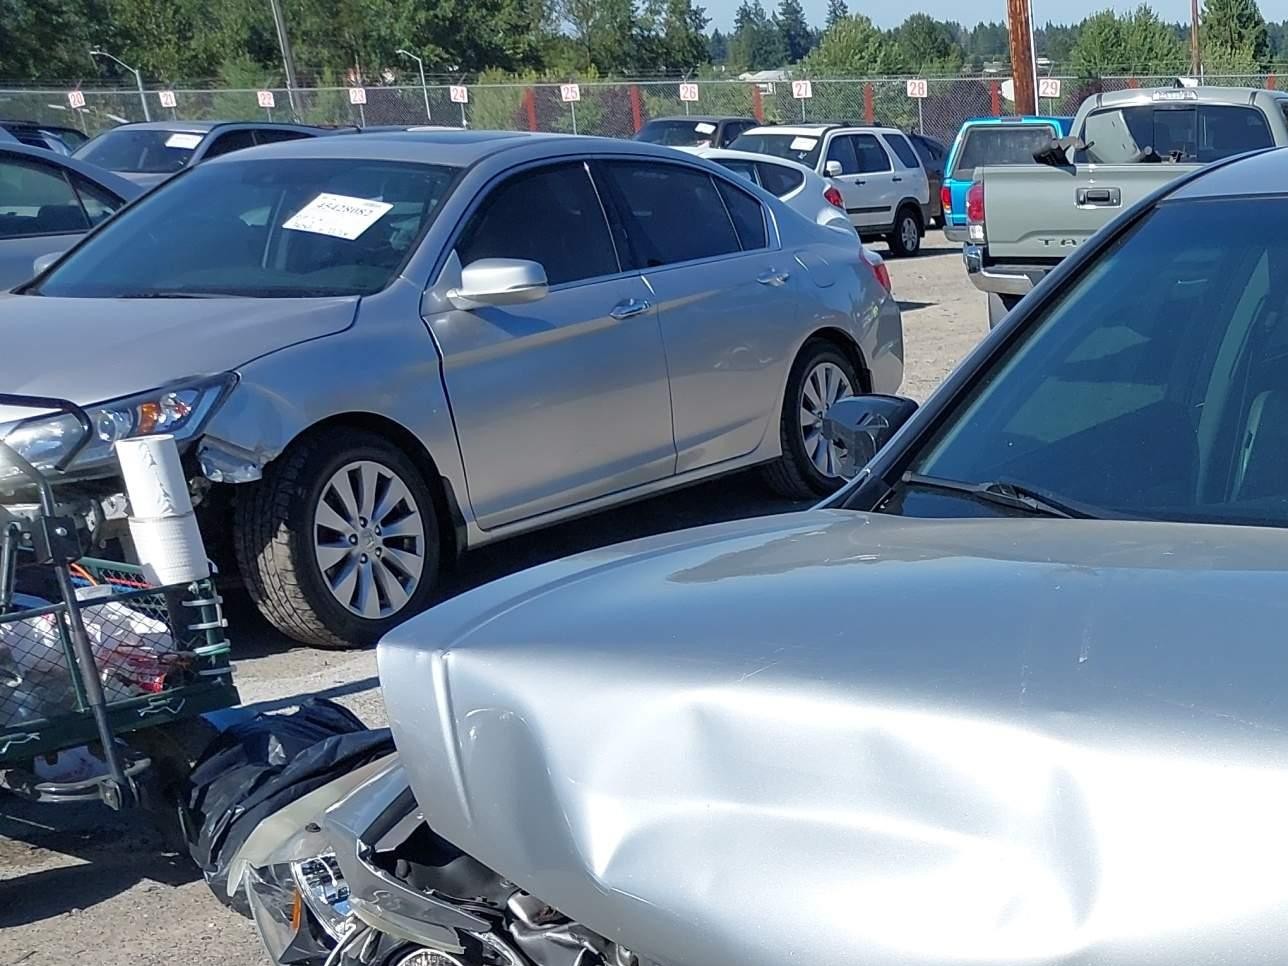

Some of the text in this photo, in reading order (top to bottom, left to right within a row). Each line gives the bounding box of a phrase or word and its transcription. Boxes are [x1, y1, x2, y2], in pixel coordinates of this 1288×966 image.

[453, 88, 466, 101] 24
[563, 86, 578, 99] 25
[682, 86, 696, 99] 26
[796, 83, 809, 96] 27
[910, 82, 925, 96] 28
[1041, 82, 1058, 95] 29
[71, 93, 83, 105] 20
[162, 93, 173, 105] 21
[351, 89, 364, 102] 23
